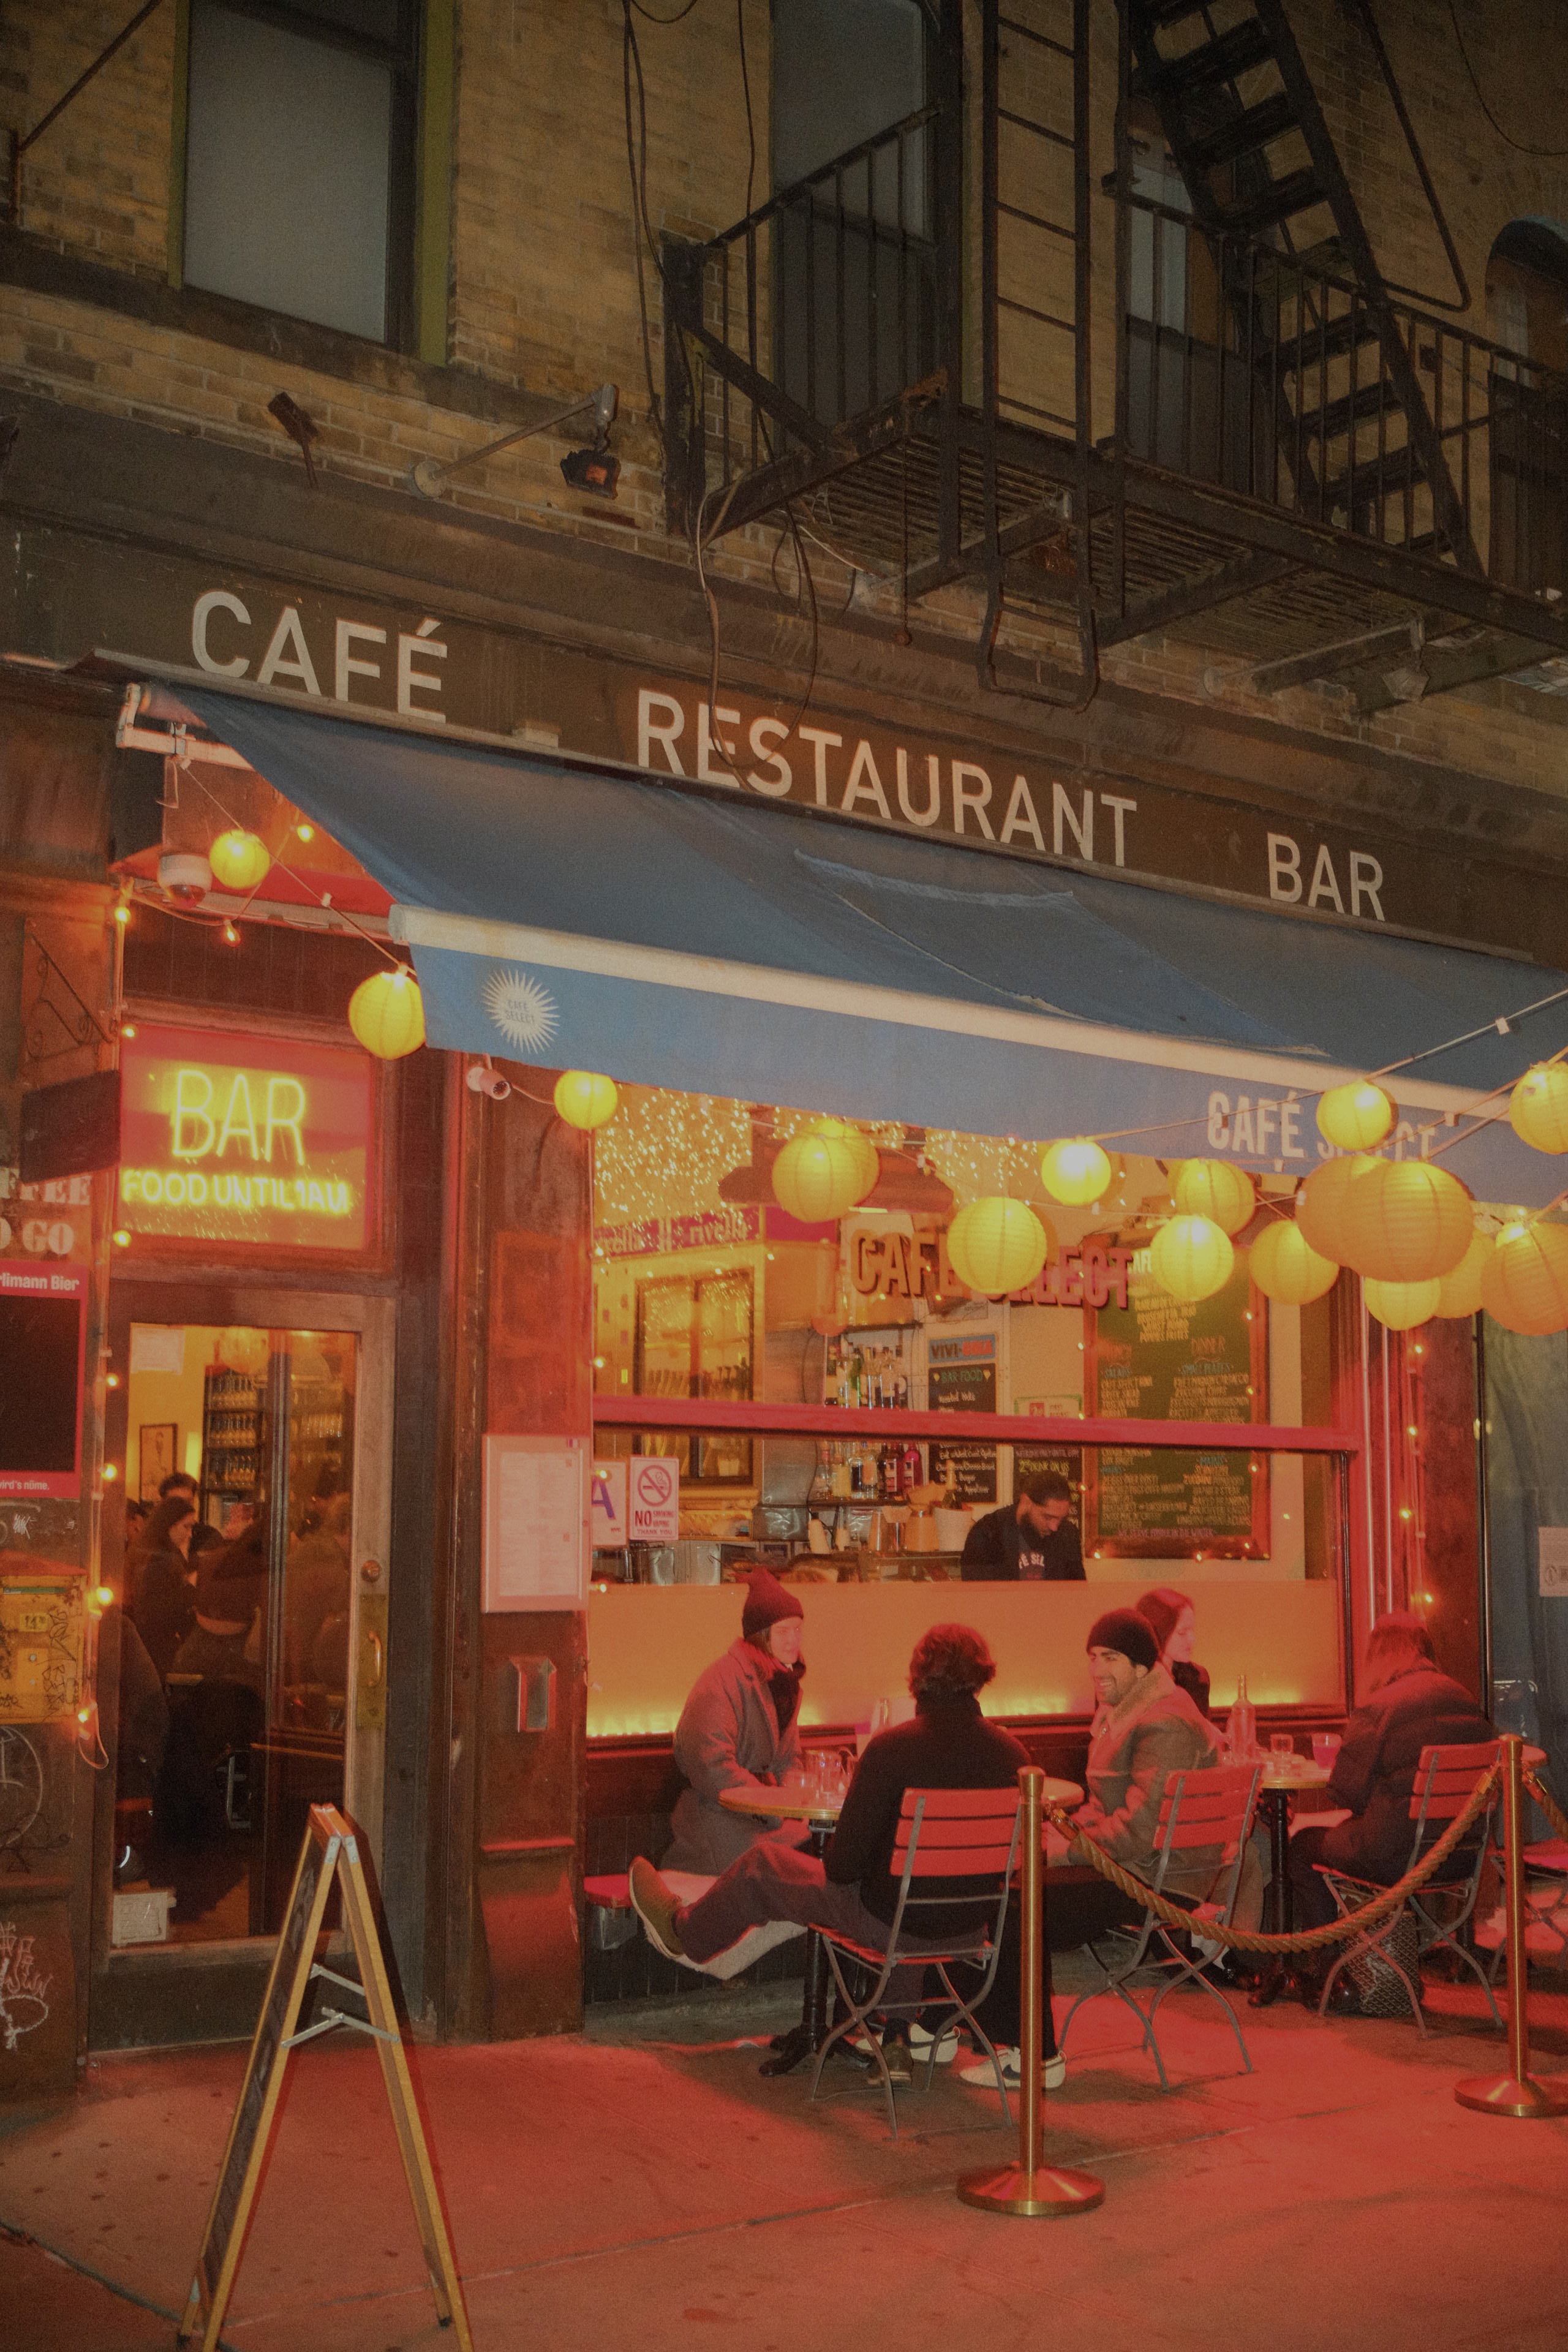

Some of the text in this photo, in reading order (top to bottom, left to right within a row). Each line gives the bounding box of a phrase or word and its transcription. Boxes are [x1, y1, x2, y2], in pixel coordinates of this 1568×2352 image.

[192, 590, 1385, 922] CAFÉ RESTAURANT BAR
[173, 1069, 307, 1166] BAR
[1208, 1091, 1305, 1158] CAFÉ
[123, 1170, 208, 1204] FOOD
[214, 1175, 295, 1210] UNTIL
[22, 1220, 75, 1255] GO
[51, 1275, 80, 1291] Bier
[932, 1340, 993, 1359] VIVI-COLA
[960, 1369, 983, 1382] FOOD
[24, 1479, 50, 1490] nüme.
[592, 1471, 616, 1520] A
[635, 1510, 652, 1527] NO
